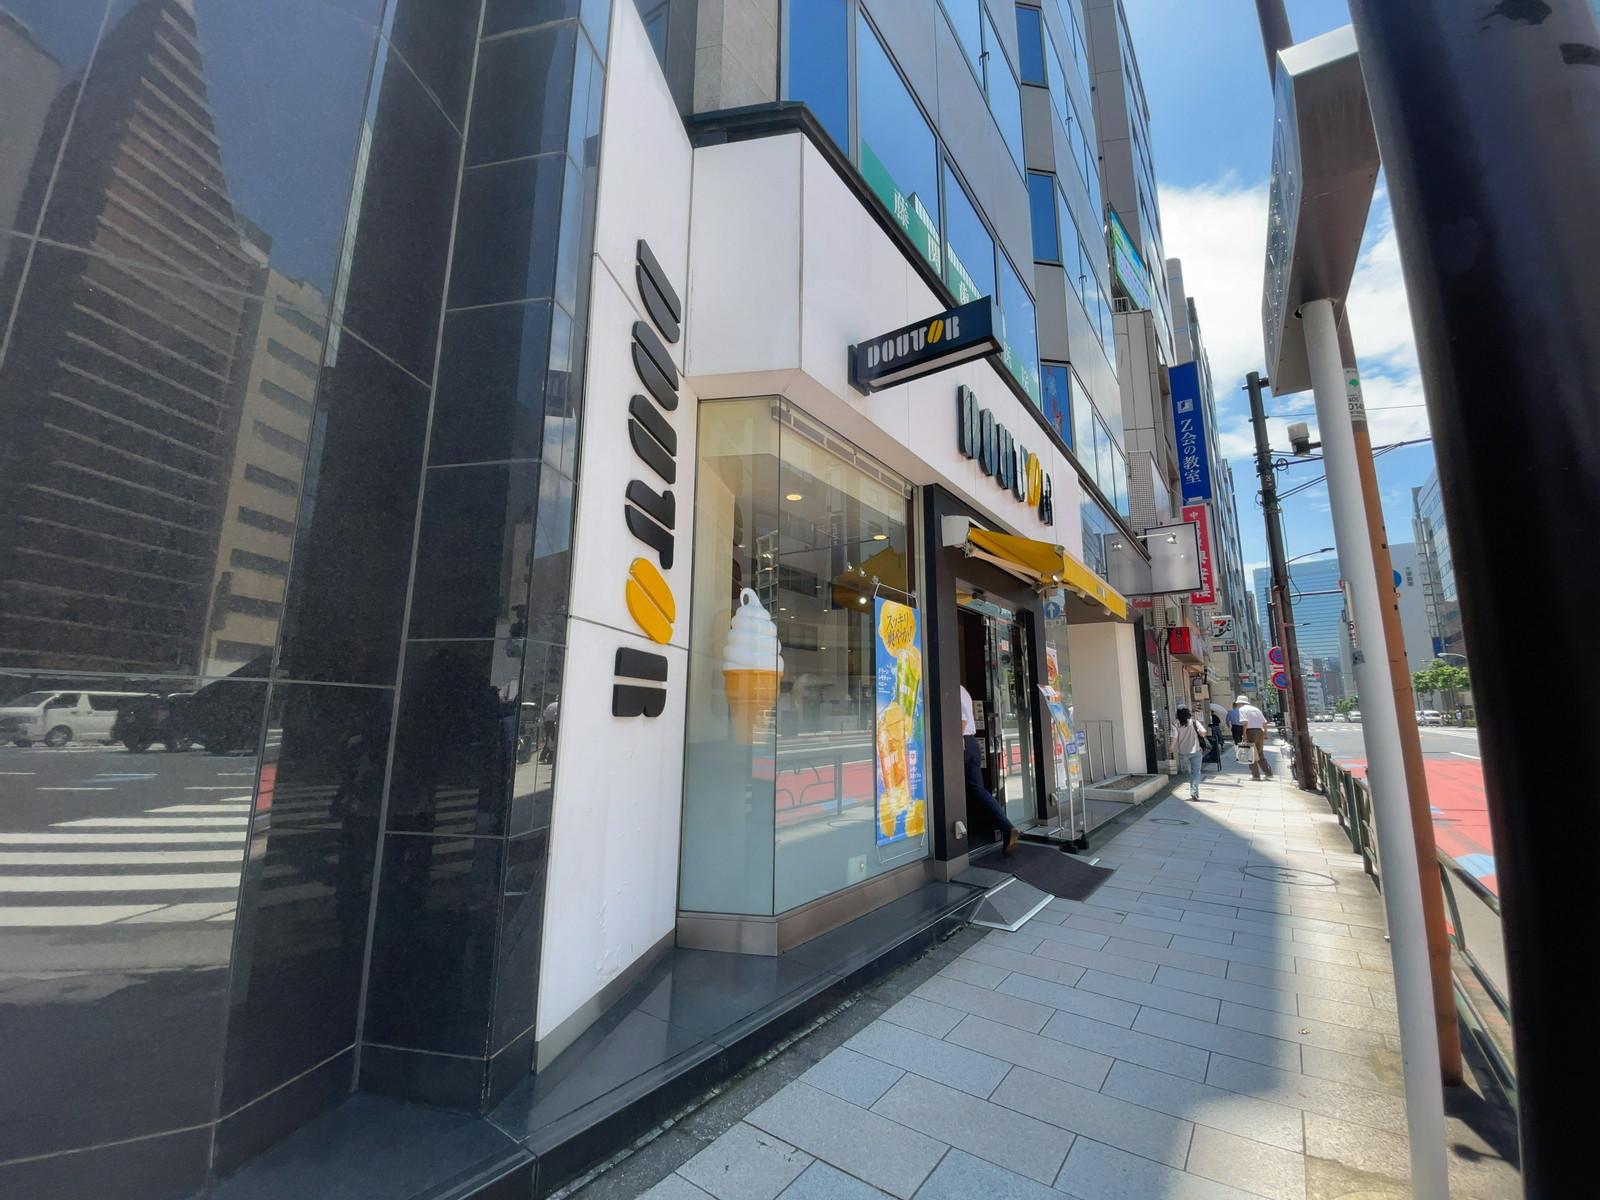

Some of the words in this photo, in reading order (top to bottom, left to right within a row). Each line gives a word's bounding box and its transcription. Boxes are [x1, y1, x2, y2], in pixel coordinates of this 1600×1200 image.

[867, 315, 960, 369] DOUTOR
[612, 238, 682, 718] DOUTOR
[957, 384, 1054, 527] DOUTOR
[1180, 418, 1202, 485] Z会の教室
[886, 612, 909, 631] スッキリ
